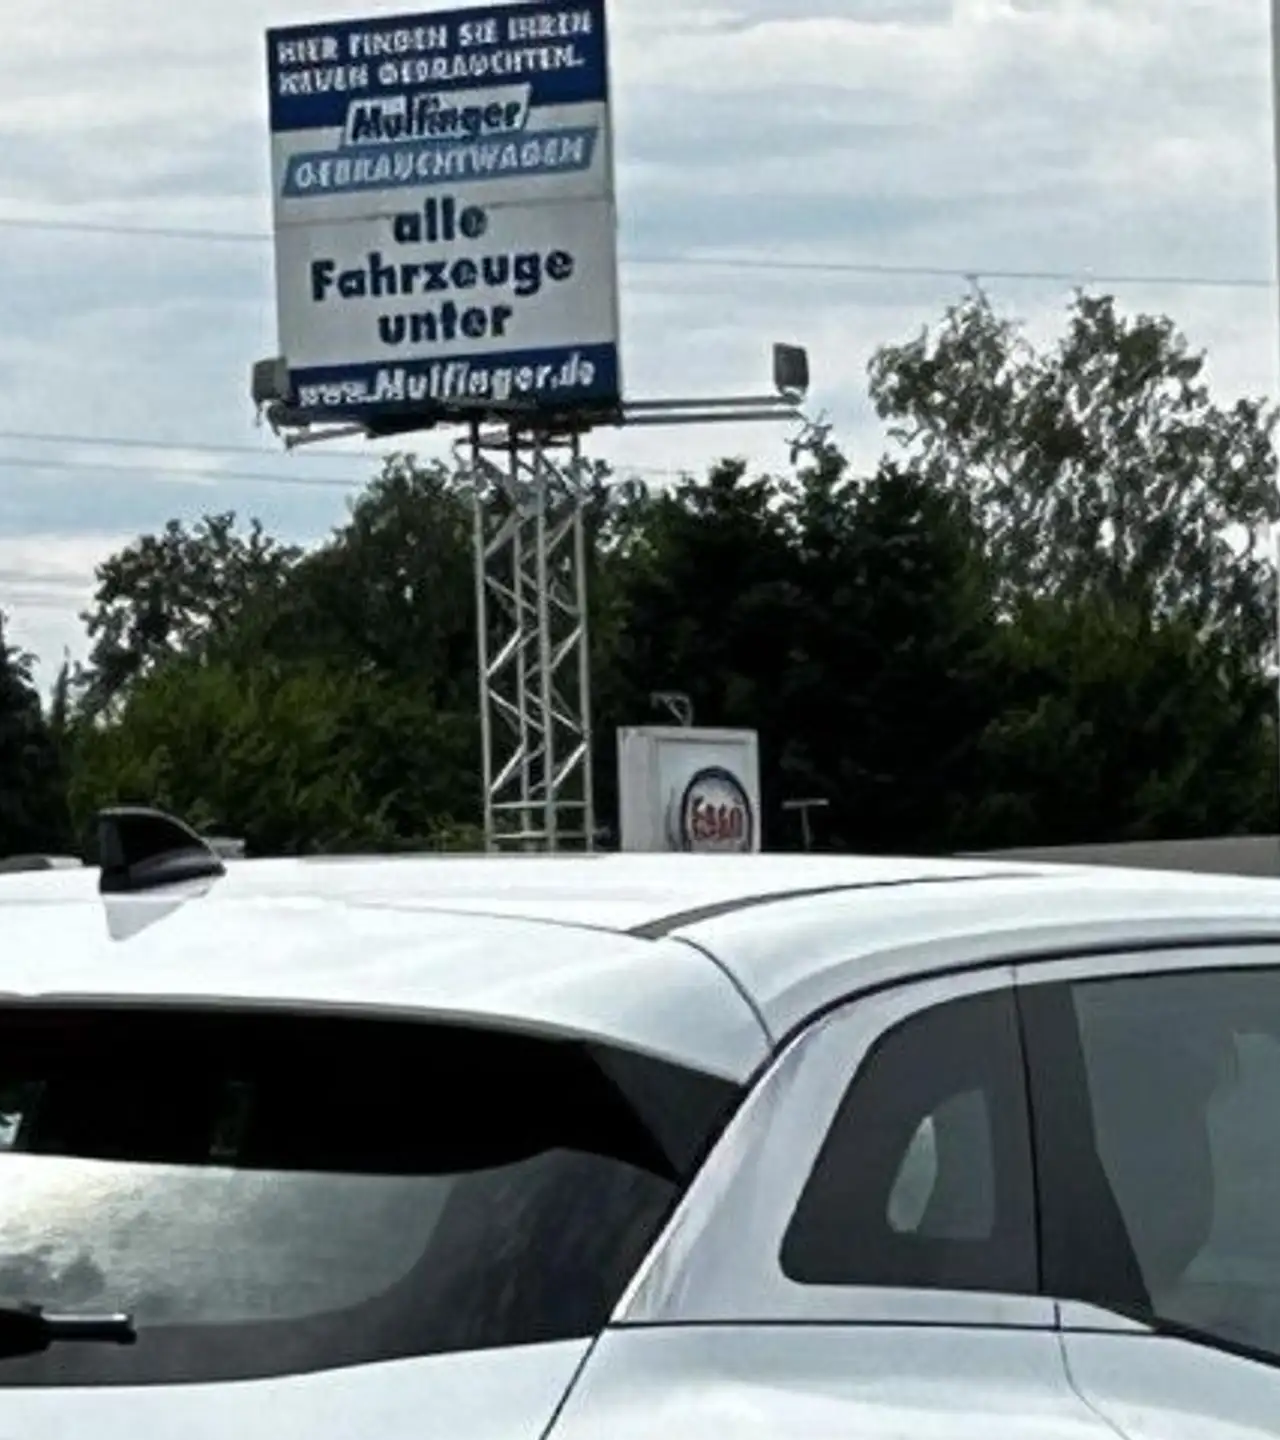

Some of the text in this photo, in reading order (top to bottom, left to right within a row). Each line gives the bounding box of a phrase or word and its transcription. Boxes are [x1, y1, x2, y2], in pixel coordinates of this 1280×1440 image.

[350, 91, 522, 142] Mulfinger
[294, 136, 587, 189] GEBRAUCHTWAGEN
[393, 197, 487, 244] alle
[311, 247, 575, 301] Fahrzeuge
[379, 299, 513, 345] unter
